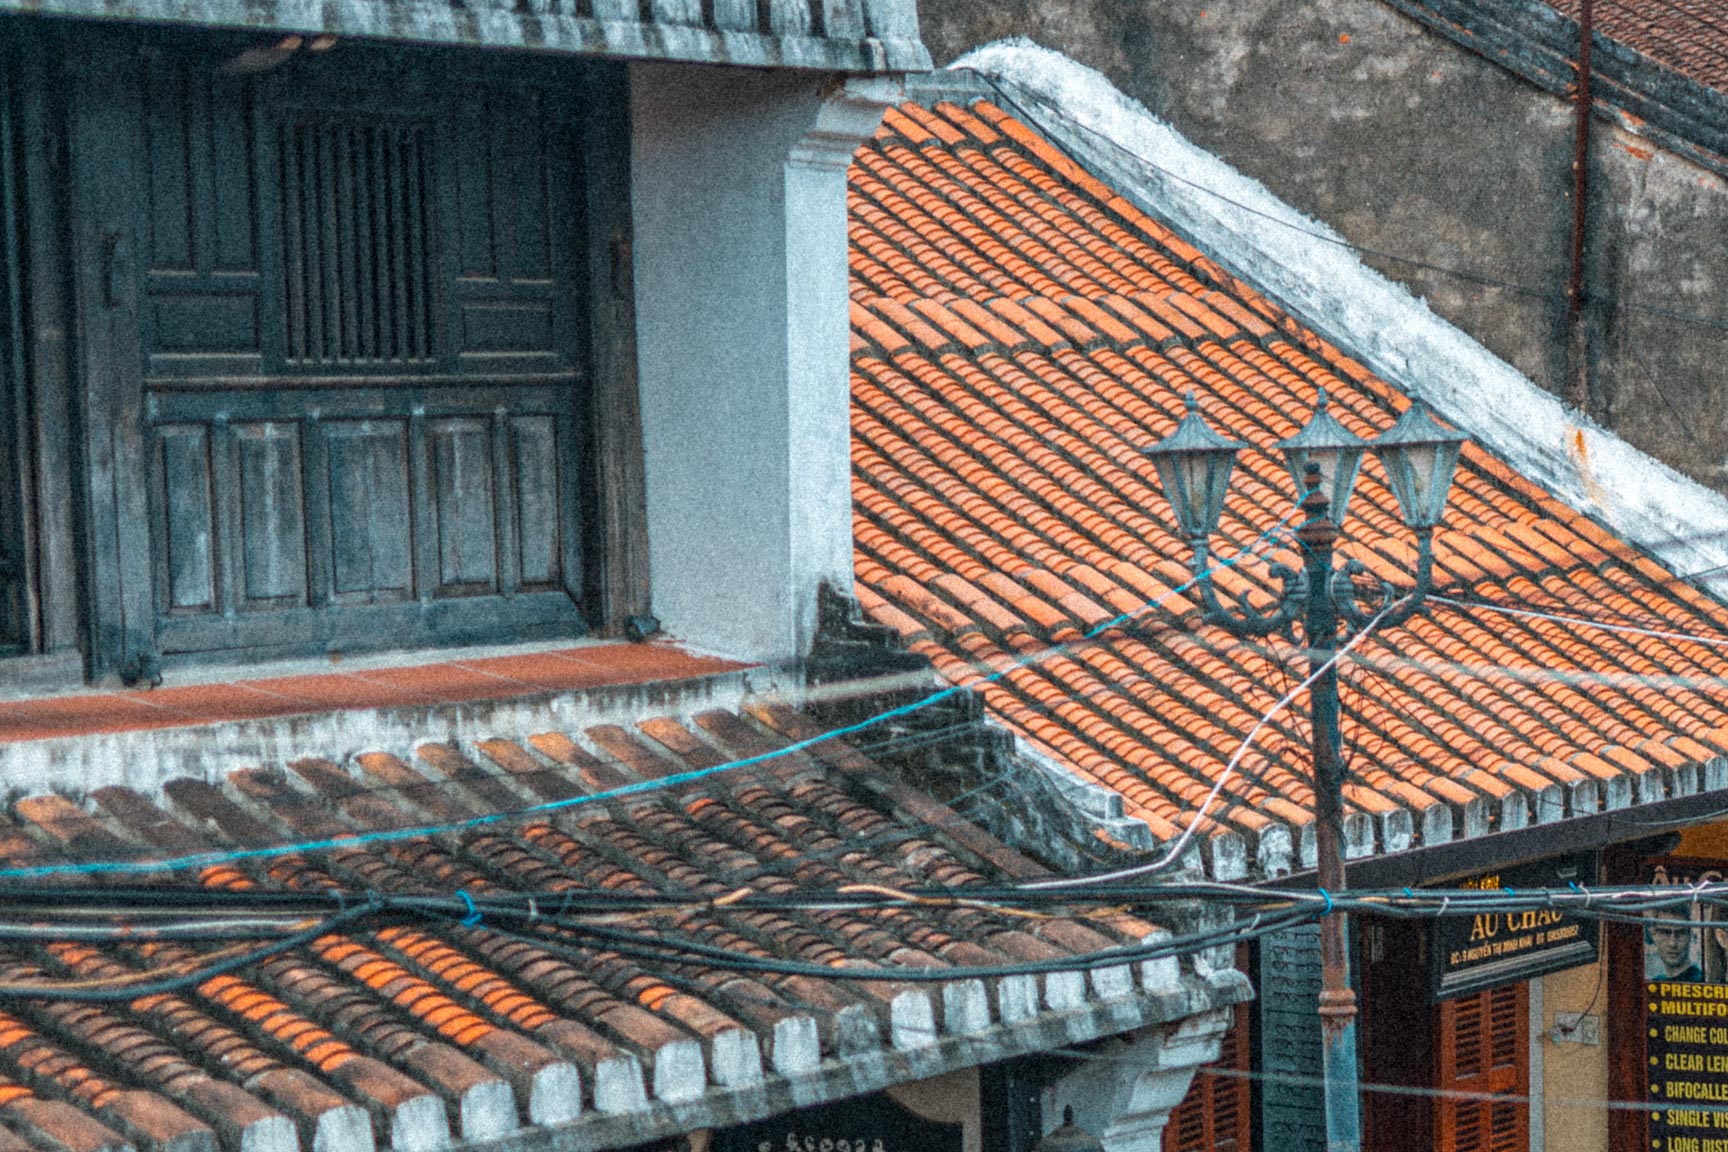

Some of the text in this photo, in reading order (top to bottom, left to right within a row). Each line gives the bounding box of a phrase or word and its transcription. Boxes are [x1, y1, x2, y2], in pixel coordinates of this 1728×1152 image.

[1664, 1025, 1707, 1044] CHANGE
[1666, 1054, 1703, 1072] CLEAR
[1667, 1110, 1709, 1128] SINGLE
